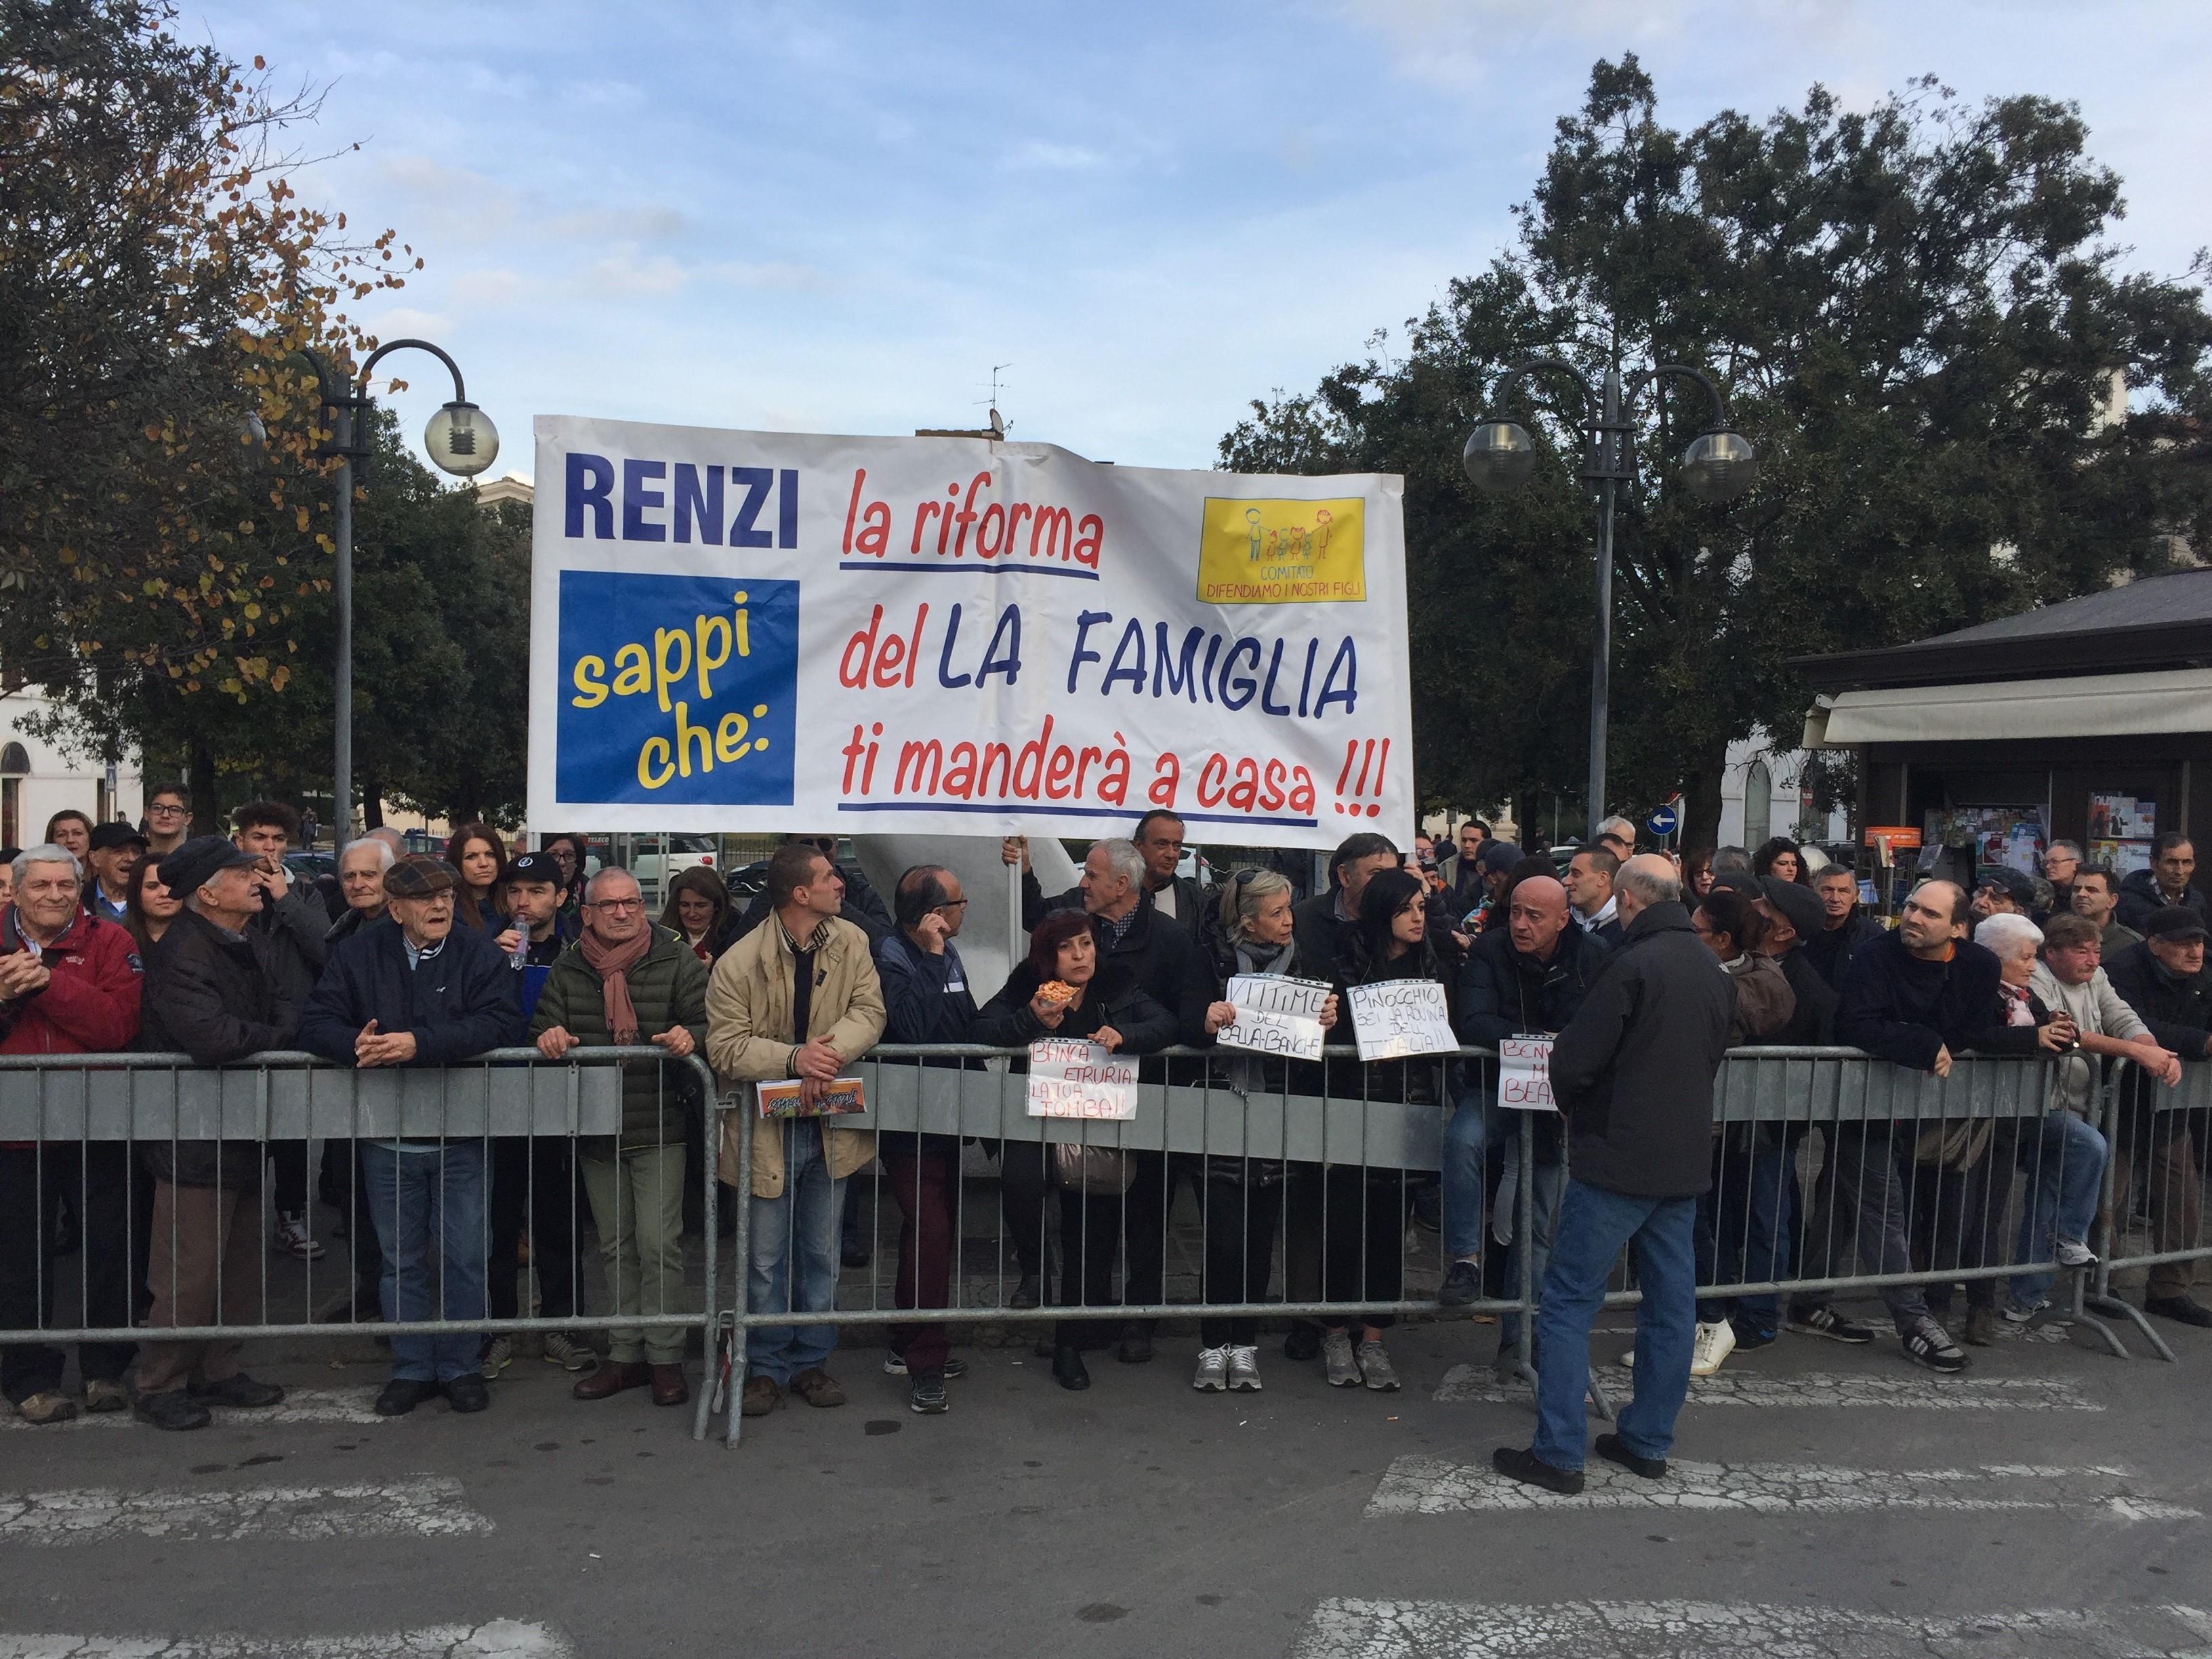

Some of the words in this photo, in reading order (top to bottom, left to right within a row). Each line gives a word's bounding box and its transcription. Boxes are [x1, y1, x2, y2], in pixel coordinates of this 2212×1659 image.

[565, 453, 799, 550] RENZI
[842, 468, 892, 558] la
[910, 471, 1105, 569] riforma
[1261, 565, 1314, 580] COMITATO
[1207, 583, 1282, 598] DIFENDIAMO
[1285, 583, 1289, 596] I
[1292, 582, 1329, 596] NOSTRI
[1334, 581, 1360, 596] FIGLI
[572, 591, 752, 713] sappi
[839, 603, 928, 689] del
[939, 603, 1021, 689] LA
[1067, 609, 1358, 719] FAMIGLIA
[637, 702, 769, 789] che:
[842, 722, 884, 796] ti
[894, 714, 1130, 806] manderà
[1148, 752, 1181, 808] a
[1197, 752, 1316, 815] casa
[1335, 737, 1391, 818] !!!
[1230, 977, 1325, 1014] VITTIME
[1353, 987, 1439, 1009] PINOCCHIO
[1250, 1010, 1288, 1029] DEL
[1357, 1011, 1380, 1026] SEI
[1388, 1008, 1403, 1021] LA
[1032, 1041, 1089, 1063] BANCA
[1502, 1040, 1552, 1059] BENV
[1064, 1066, 1131, 1084] ETRURIA
[1532, 1063, 1544, 1080] M
[1031, 1082, 1049, 1097] LA
[1052, 1082, 1082, 1098] TUA
[1504, 1078, 1555, 1105] BEA
